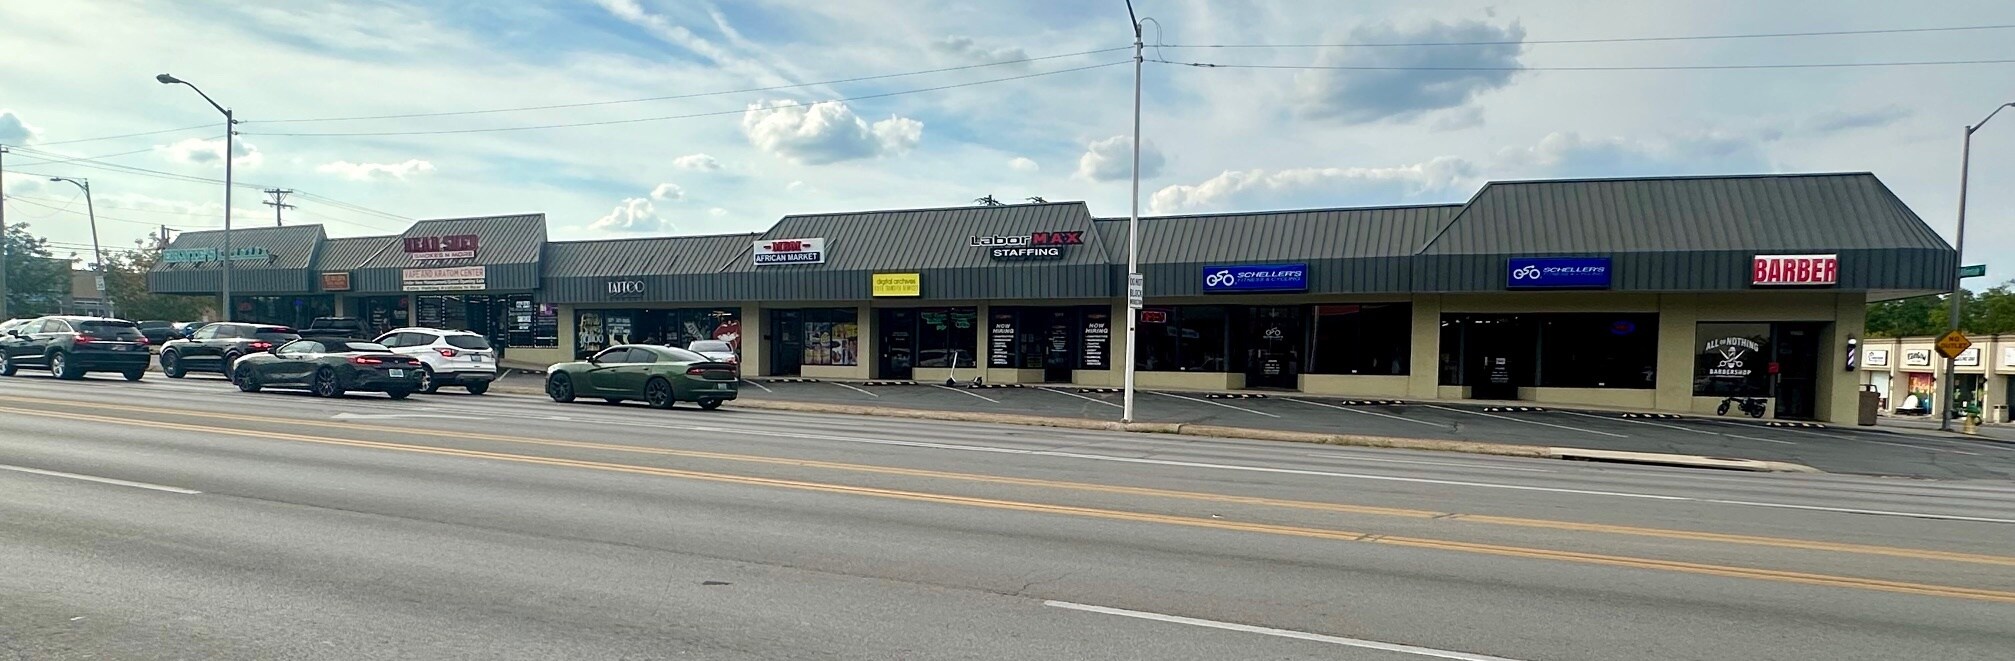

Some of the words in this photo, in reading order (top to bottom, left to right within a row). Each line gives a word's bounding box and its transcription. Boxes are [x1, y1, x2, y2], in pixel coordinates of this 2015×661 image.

[756, 254, 786, 262] AFRICAN
[788, 252, 817, 261] MARKET
[993, 248, 1059, 257] STAFFING
[404, 270, 421, 279] VAPE
[421, 269, 434, 278] AND
[435, 268, 459, 278] KRATOM
[460, 268, 484, 277] CENTER
[1237, 270, 1303, 278] SCHELLER'S
[1753, 258, 1837, 283] BARBER
[1705, 339, 1720, 351] ALL
[1726, 337, 1759, 352] NOTHING
